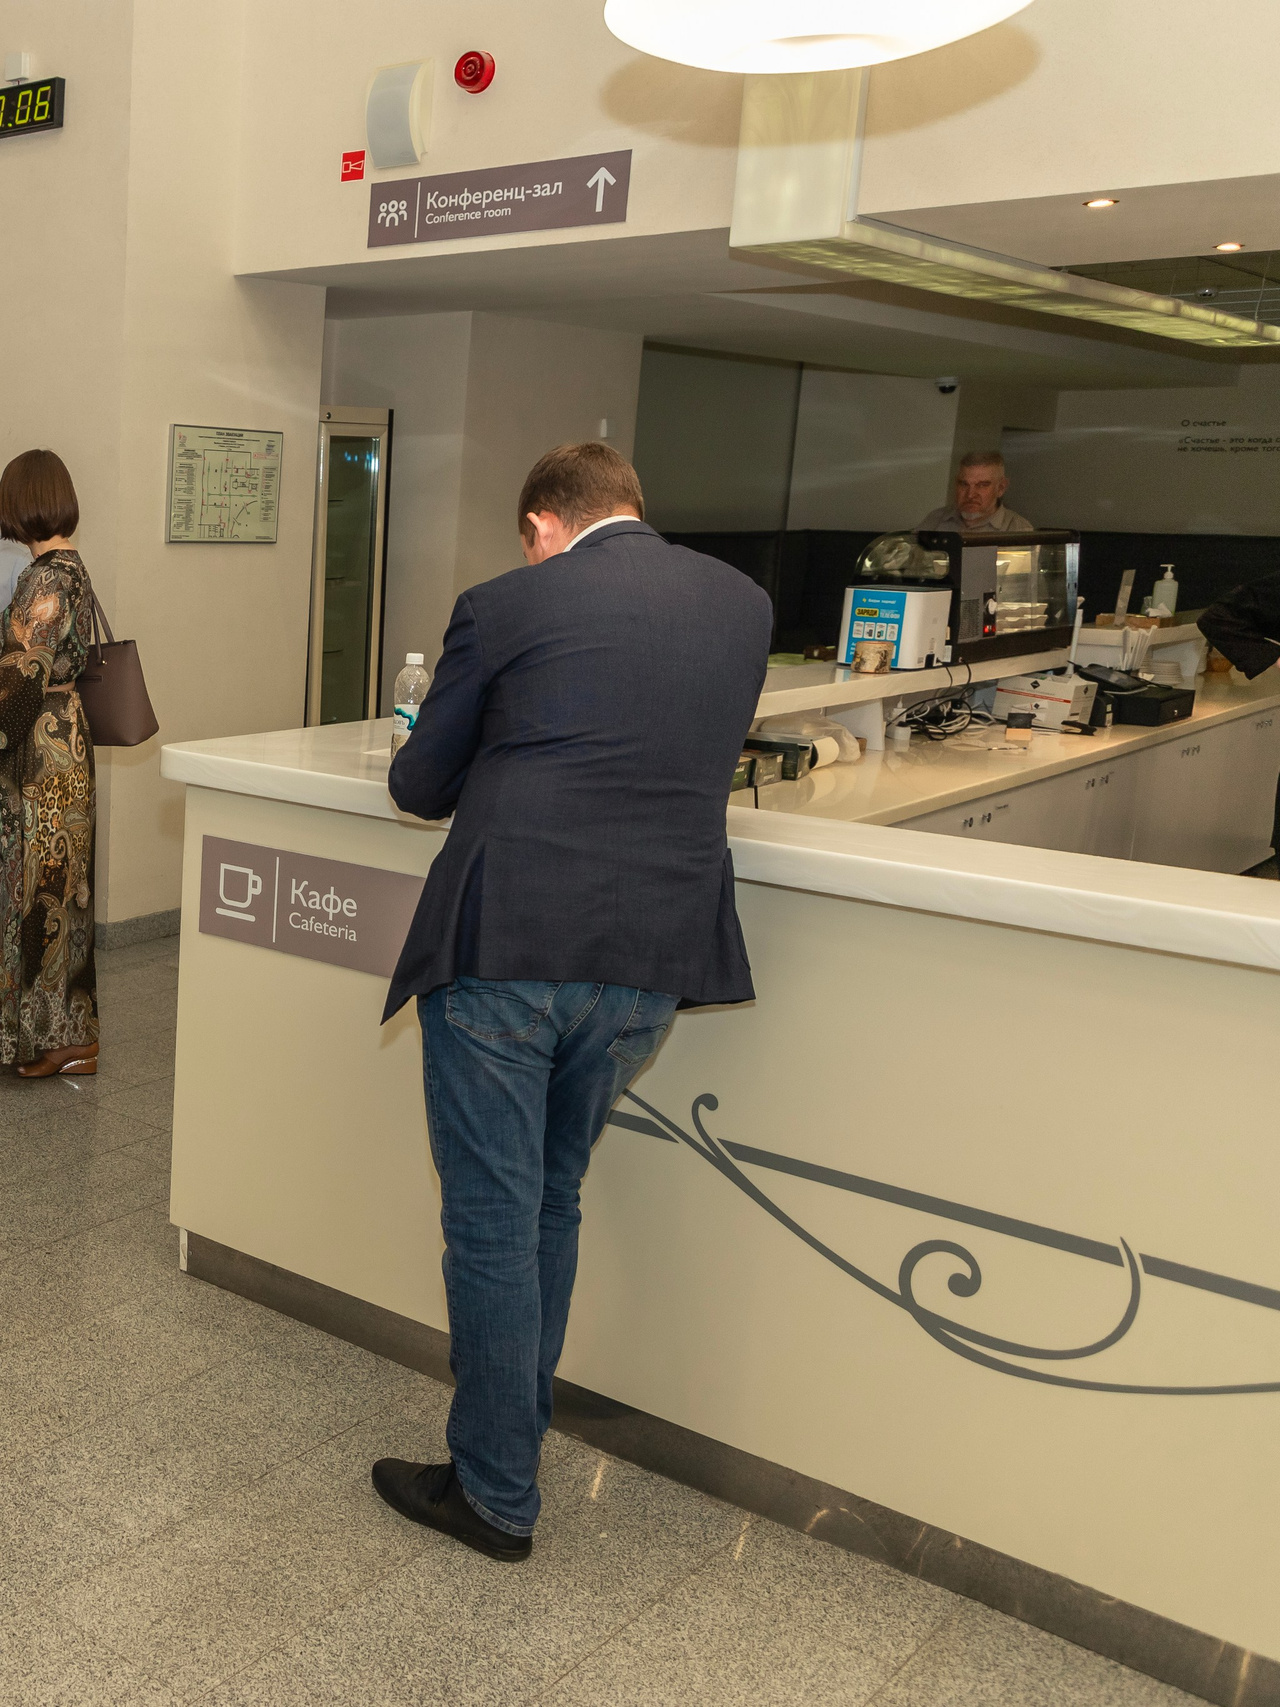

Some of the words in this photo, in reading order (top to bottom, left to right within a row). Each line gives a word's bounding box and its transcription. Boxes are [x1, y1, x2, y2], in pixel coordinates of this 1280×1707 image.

[426, 181, 563, 210] Конференц-зал
[425, 209, 481, 225] Conference
[483, 206, 512, 218] room
[290, 878, 358, 921] Кафе
[288, 912, 357, 942] Cafeteria
